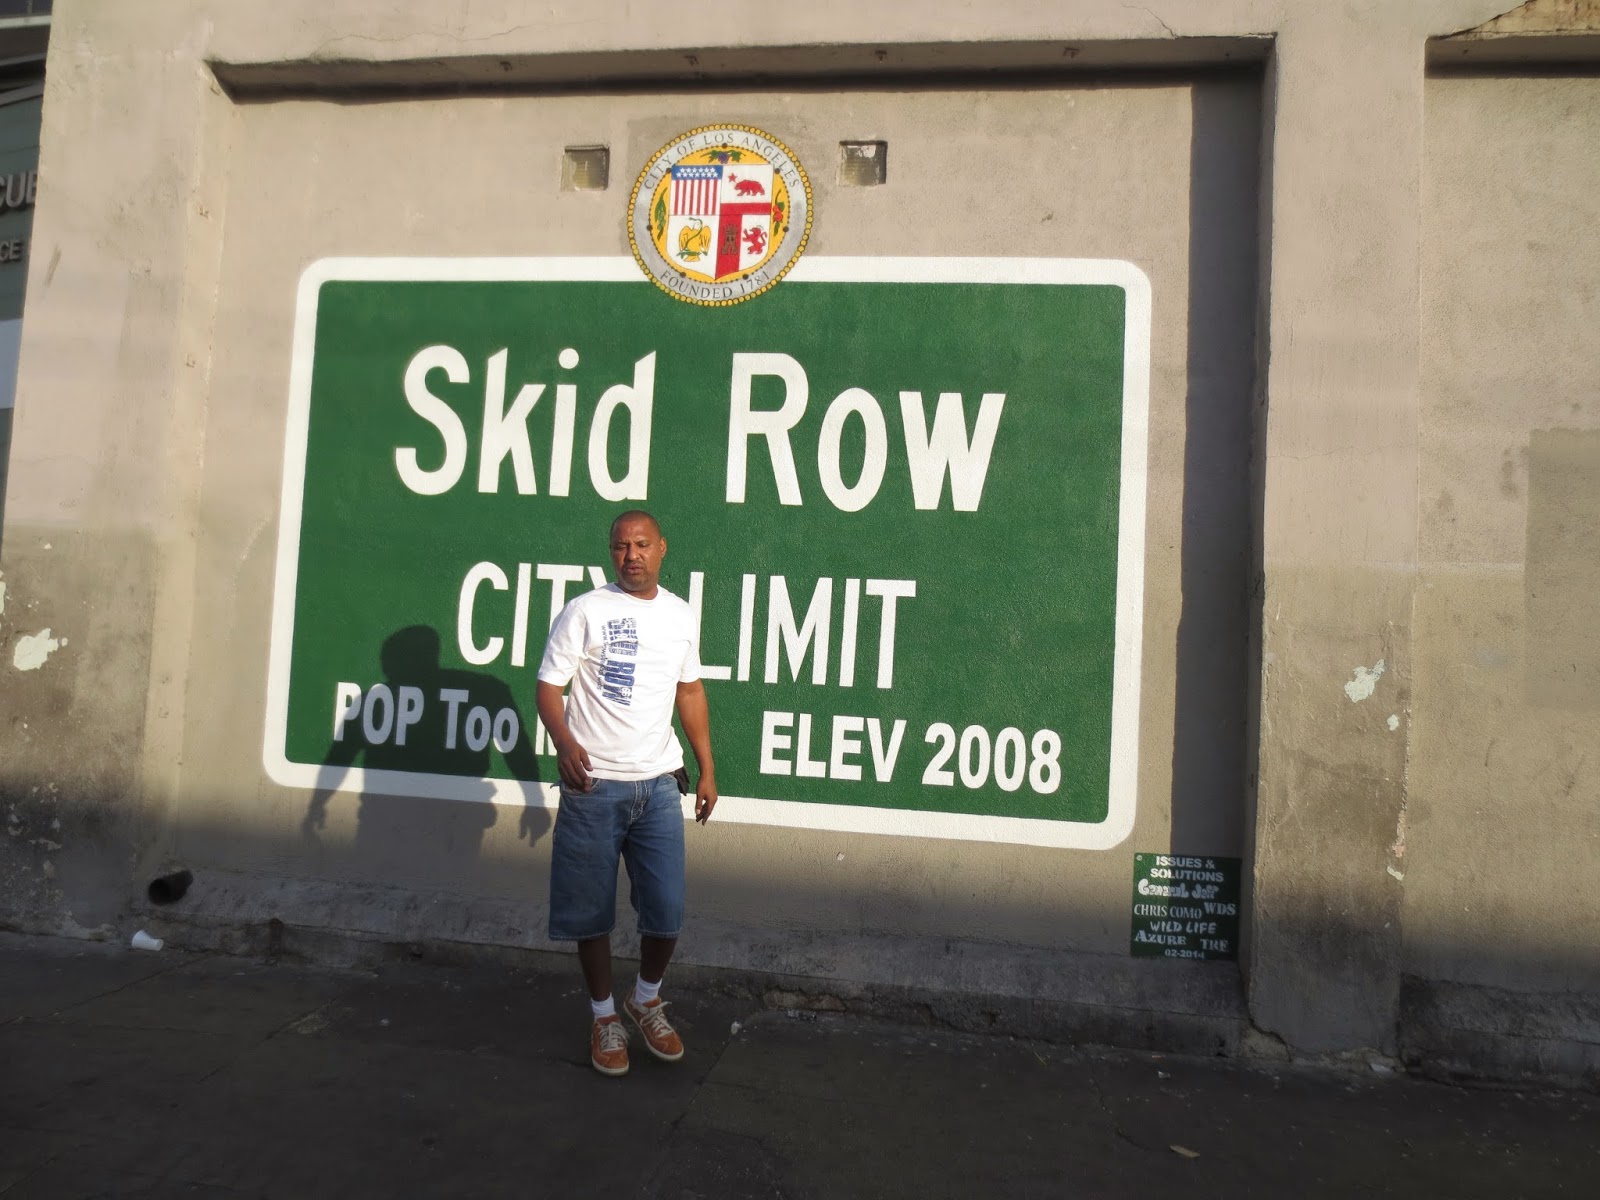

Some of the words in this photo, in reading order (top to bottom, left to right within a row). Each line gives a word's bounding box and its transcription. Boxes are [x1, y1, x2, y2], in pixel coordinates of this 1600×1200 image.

[644, 157, 672, 190] CITY
[676, 139, 696, 155] OF
[703, 132, 734, 145] LOS
[741, 137, 800, 189] ANGELES
[659, 269, 733, 299] FOUNDED
[740, 272, 771, 294] 1781
[395, 344, 656, 502] Skid
[725, 352, 1006, 513] Row
[457, 561, 608, 667] CIT
[688, 571, 916, 689] LIMIT
[333, 681, 425, 745] POP
[759, 710, 907, 782] ELEV
[921, 722, 1061, 794] 2008
[1150, 868, 1224, 882] SOLUTIONS
[1155, 855, 1202, 868] ISSUES
[1205, 859, 1216, 869] &
[1133, 904, 1168, 917] CHRIS
[1169, 905, 1202, 919] COMO
[1203, 901, 1236, 916] WDS
[1150, 921, 1182, 932] WILD
[1186, 921, 1217, 934] LIFE
